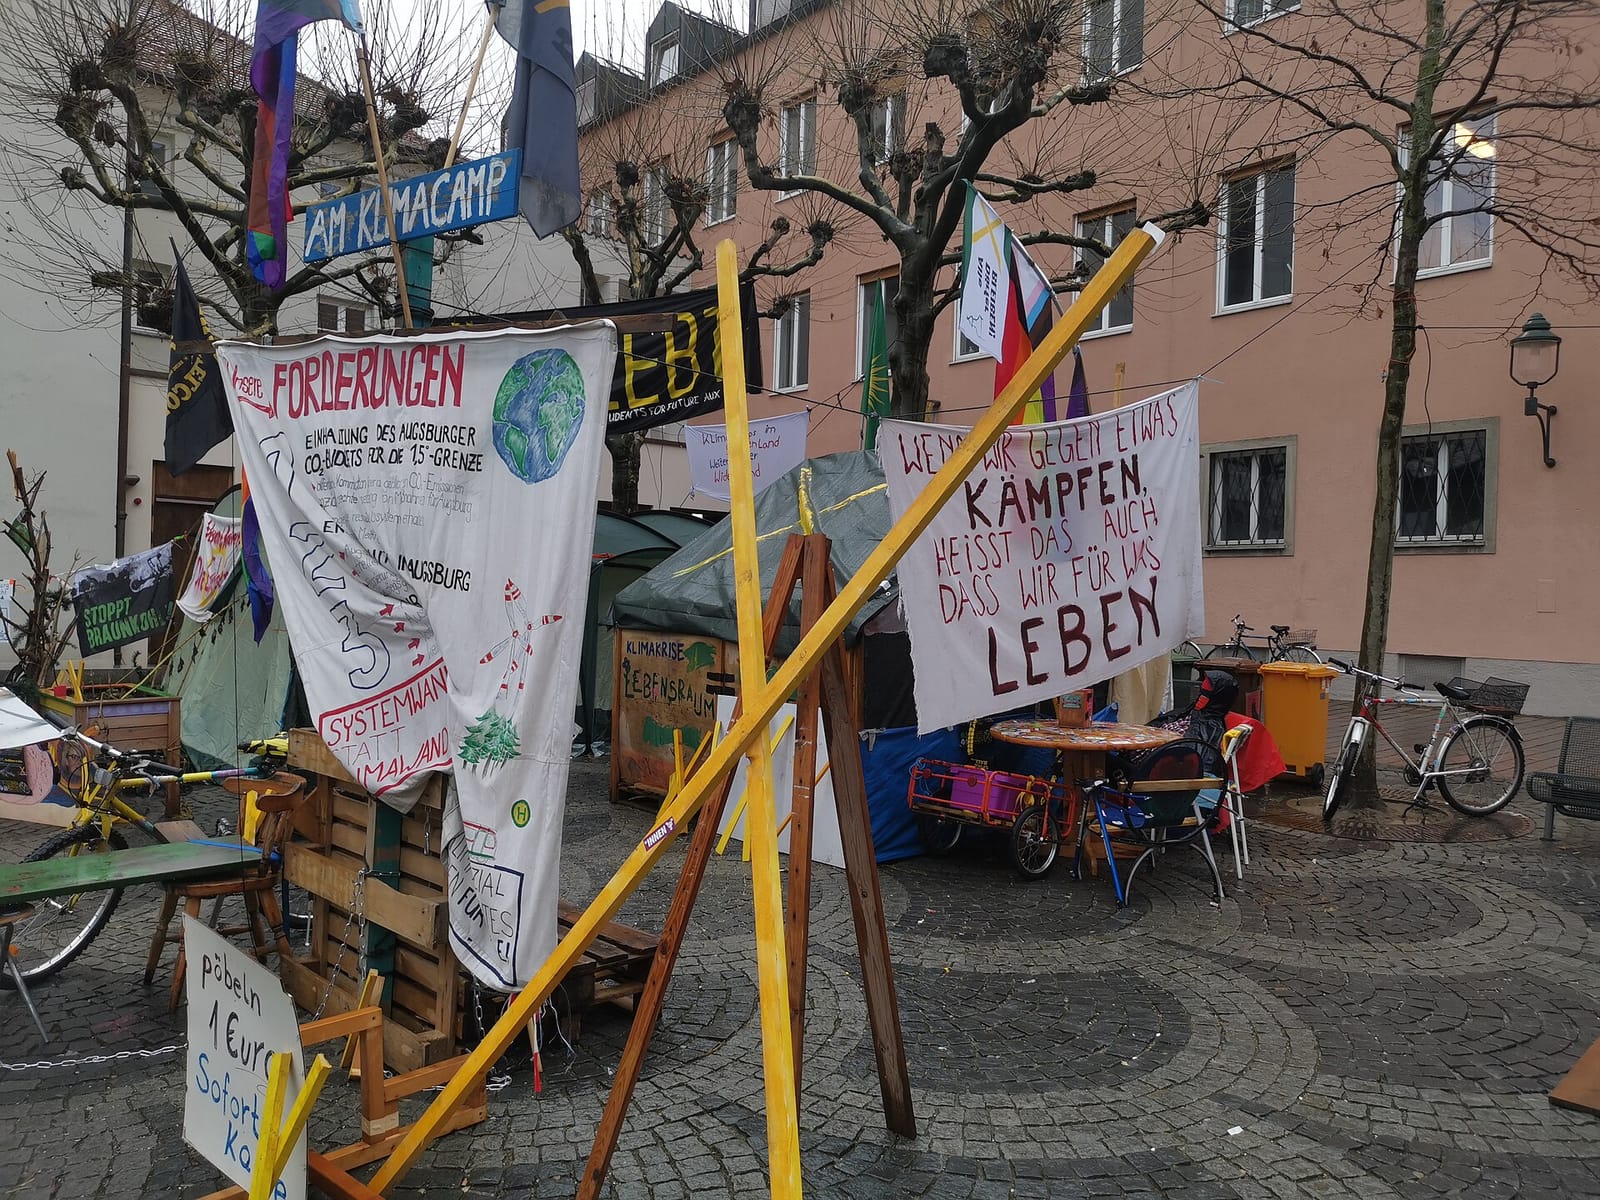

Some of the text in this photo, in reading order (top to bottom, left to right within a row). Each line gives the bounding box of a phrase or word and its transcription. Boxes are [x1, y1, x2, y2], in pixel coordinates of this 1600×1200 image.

[305, 158, 506, 257] AM KLIMACAMP
[273, 344, 465, 420] FORDERUNGEN
[608, 406, 648, 422] UDENTS
[666, 395, 700, 413] FUTURE
[376, 423, 396, 443] DES
[398, 421, 477, 447] AUGSBURGER
[1029, 421, 1101, 469] GEGEN
[1116, 394, 1178, 452] ETWAS
[964, 454, 1148, 530] KÄMPFEN,
[1030, 519, 1073, 560] DAS
[84, 597, 132, 628] STOPPT
[938, 573, 1000, 624] DASS
[1072, 546, 1115, 598] FÜR
[1121, 536, 1161, 580] WAS
[626, 640, 685, 661] KLIMAKRISE
[987, 575, 1161, 696] LEBEN
[326, 664, 449, 747] SYSTEMWAN
[623, 667, 716, 720] LEBENSRAUM
[202, 952, 262, 1017] pöbeln
[209, 999, 219, 1050] 1
[195, 1052, 260, 1140] Sofort
